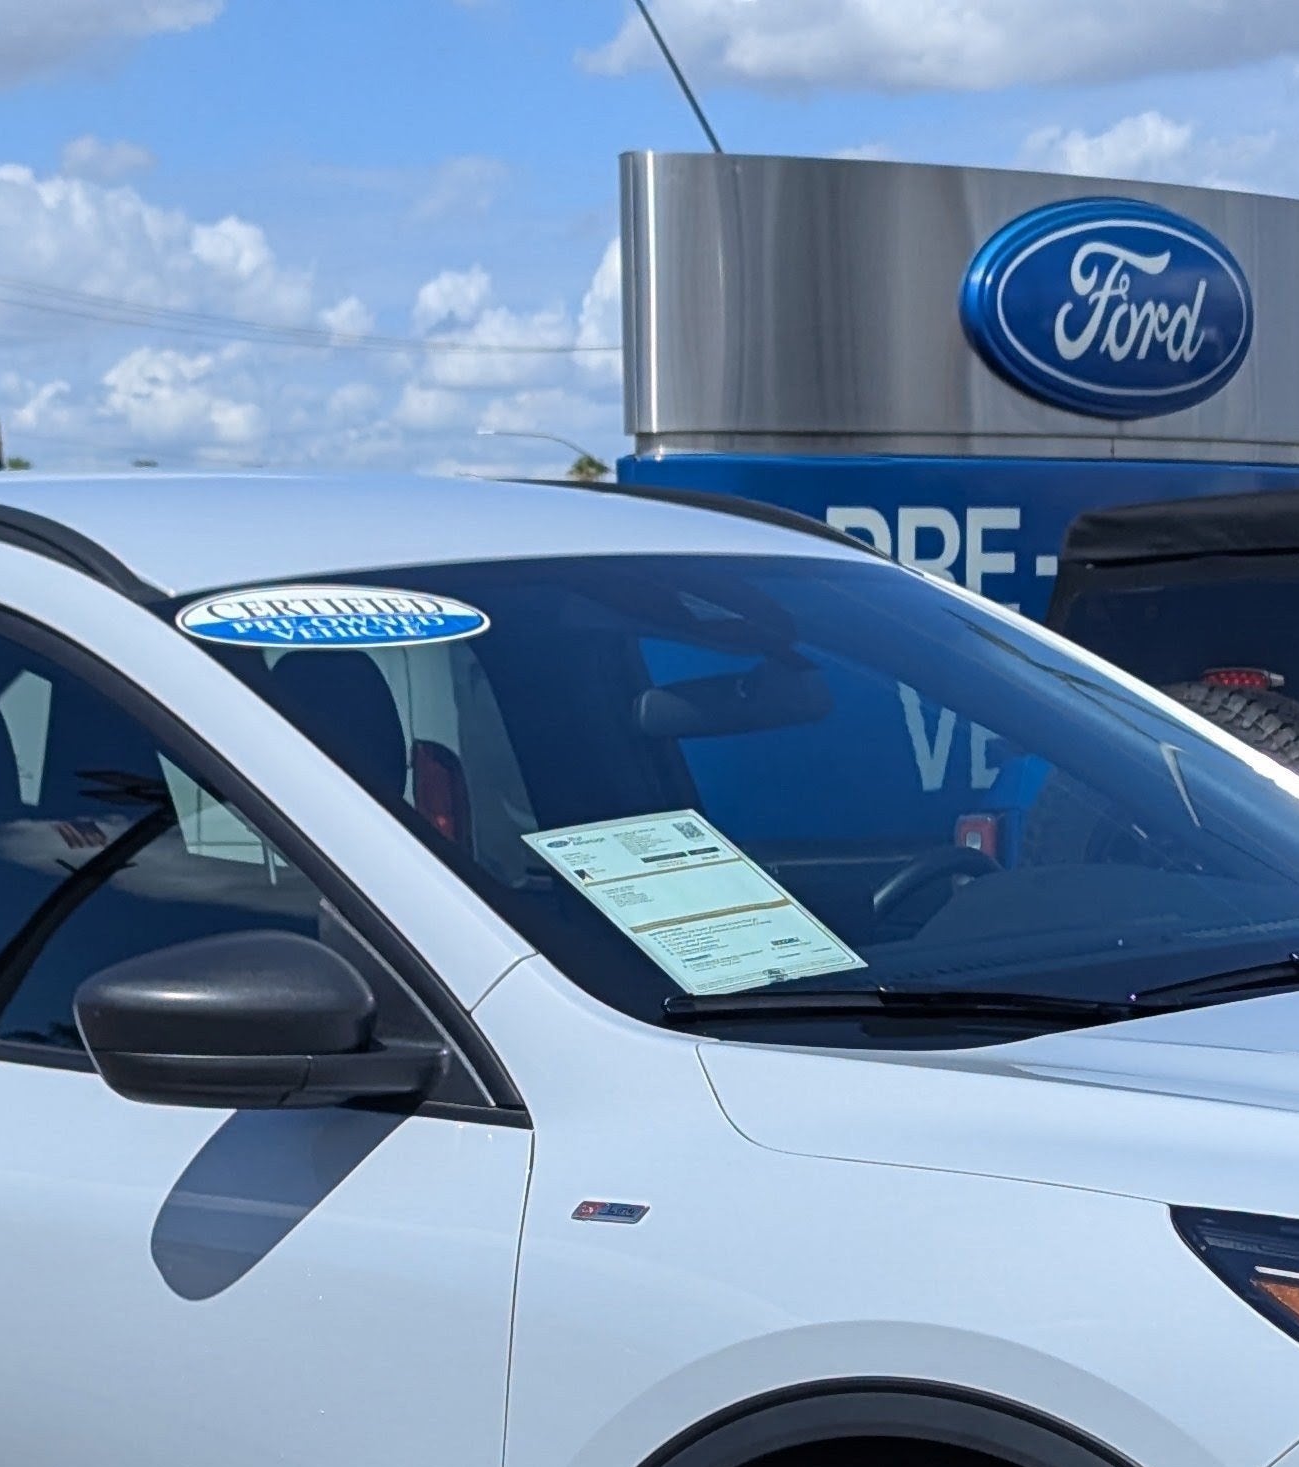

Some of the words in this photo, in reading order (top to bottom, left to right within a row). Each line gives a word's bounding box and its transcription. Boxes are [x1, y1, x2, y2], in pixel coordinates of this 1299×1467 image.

[1054, 240, 1207, 362] Ford
[206, 597, 444, 623] CERTIFIED
[230, 614, 445, 634] PRE-OWNED
[271, 624, 428, 641] VEHICLE
